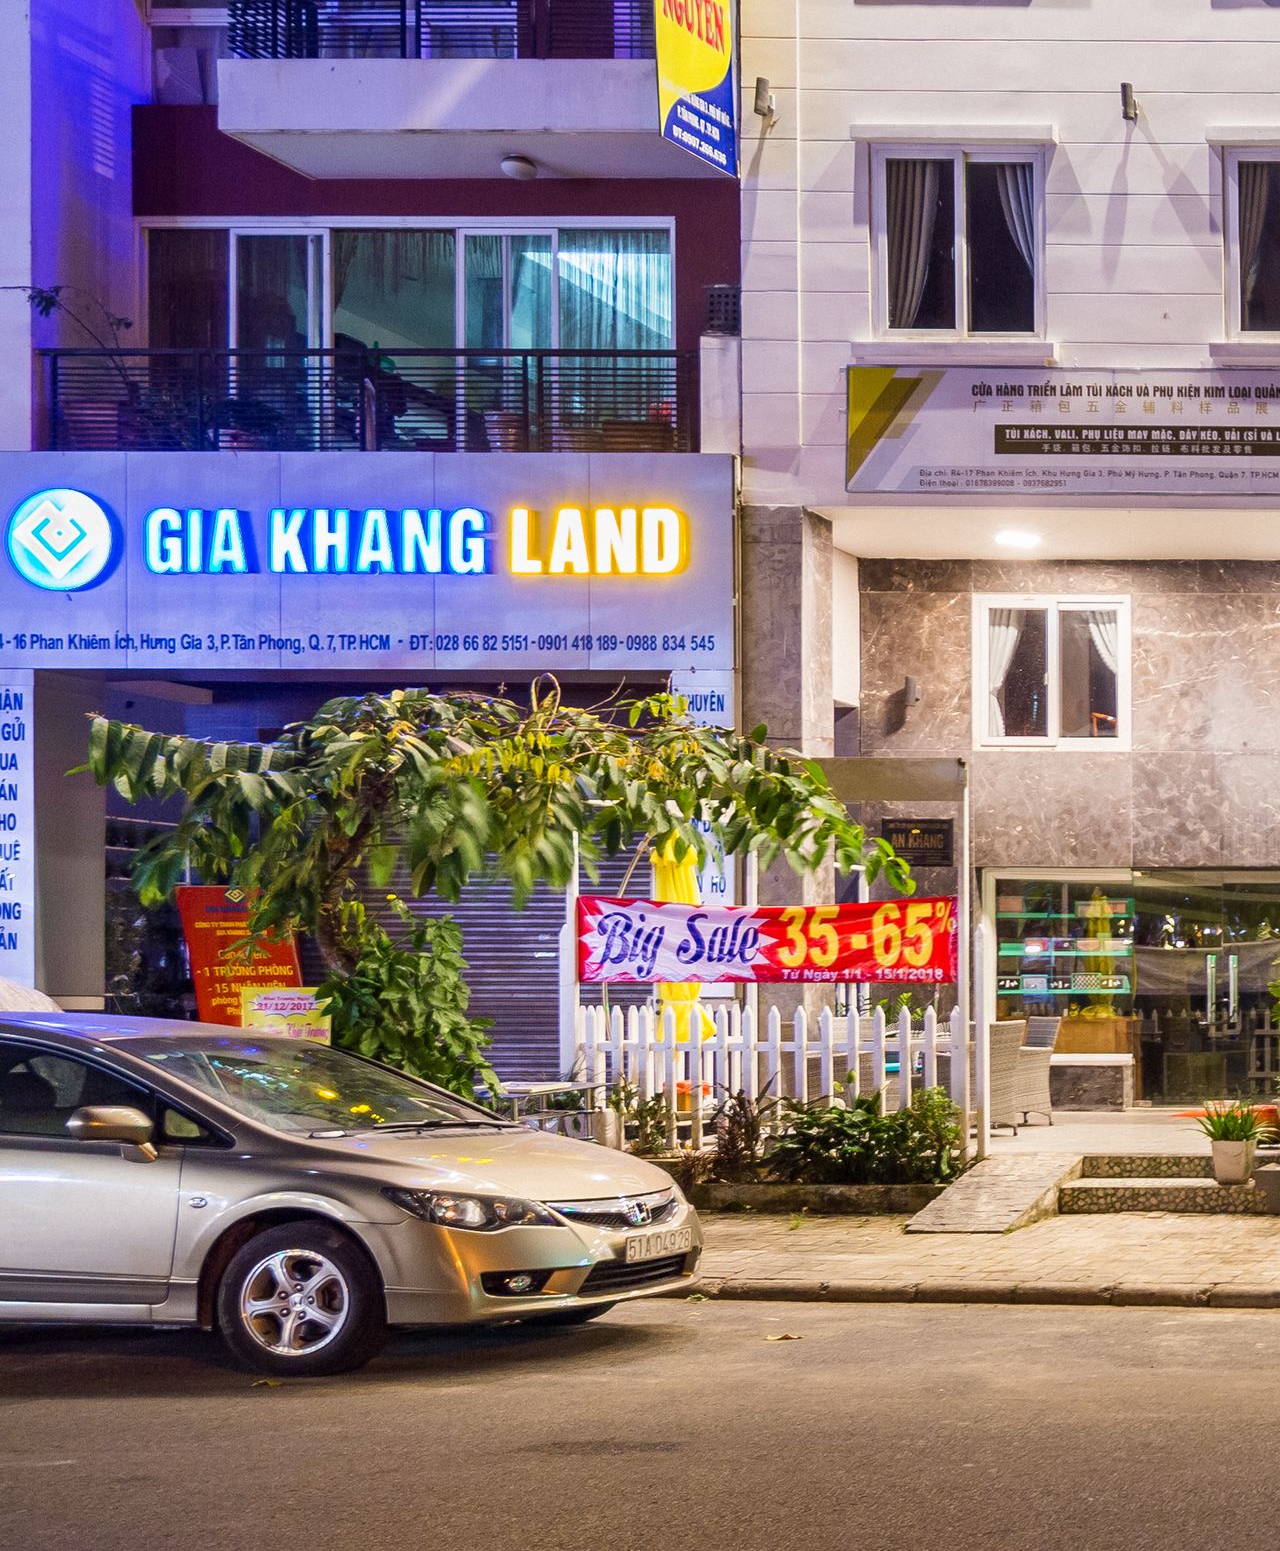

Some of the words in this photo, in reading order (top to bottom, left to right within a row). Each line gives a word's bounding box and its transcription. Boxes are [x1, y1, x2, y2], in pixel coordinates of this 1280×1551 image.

[971, 381, 993, 397] CỬA
[995, 382, 1024, 397] HÀNG
[1028, 380, 1057, 397] TRIỂN
[1087, 382, 1102, 397] TÚI
[1105, 382, 1133, 397] XÁCH
[1136, 383, 1150, 398] VÀ
[1153, 385, 1174, 401] PHỤ
[1177, 384, 1201, 401] KIỆN
[1204, 386, 1225, 399] KIM
[1228, 386, 1252, 401] LOẠI
[1005, 427, 1021, 439] TÚI
[1082, 429, 1101, 441] PHỤ
[1104, 428, 1125, 441] LIỆU
[1127, 429, 1149, 440] MAY
[1224, 428, 1240, 441] VẢI
[1260, 429, 1273, 441] VÀ
[976, 469, 996, 478] Phan
[1042, 470, 1058, 478] Khu
[1083, 470, 1096, 478] Gia
[146, 506, 248, 575] GIA
[268, 506, 487, 575] KHANG
[509, 507, 683, 575] LAND
[30, 634, 64, 650] Phan
[68, 633, 111, 650] Khiêm
[140, 633, 176, 653] Hưng
[180, 634, 203, 650] Gia
[258, 634, 305, 653] Phong,
[435, 634, 460, 651] 028
[463, 634, 479, 651] 66
[482, 634, 498, 651] 82
[571, 634, 593, 651] 418
[662, 634, 686, 651] 834
[690, 634, 715, 651] 545
[682, 690, 725, 713] HUYÊN
[0, 753, 19, 771] UA
[0, 778, 18, 801] ÁN
[0, 813, 17, 831] HO
[908, 833, 944, 849] KHANG
[0, 926, 18, 950] ẢN
[597, 911, 666, 978] Big
[676, 912, 760, 965] Sale
[259, 963, 294, 976] PHÒNG
[781, 968, 800, 980] Từ
[803, 969, 838, 983] Ngày
[843, 969, 862, 980] 1/1
[875, 968, 944, 981] 15/1/2018
[215, 983, 229, 993] 15
[212, 996, 238, 1006] phòng
[257, 1002, 314, 1011] 31/12/2017
